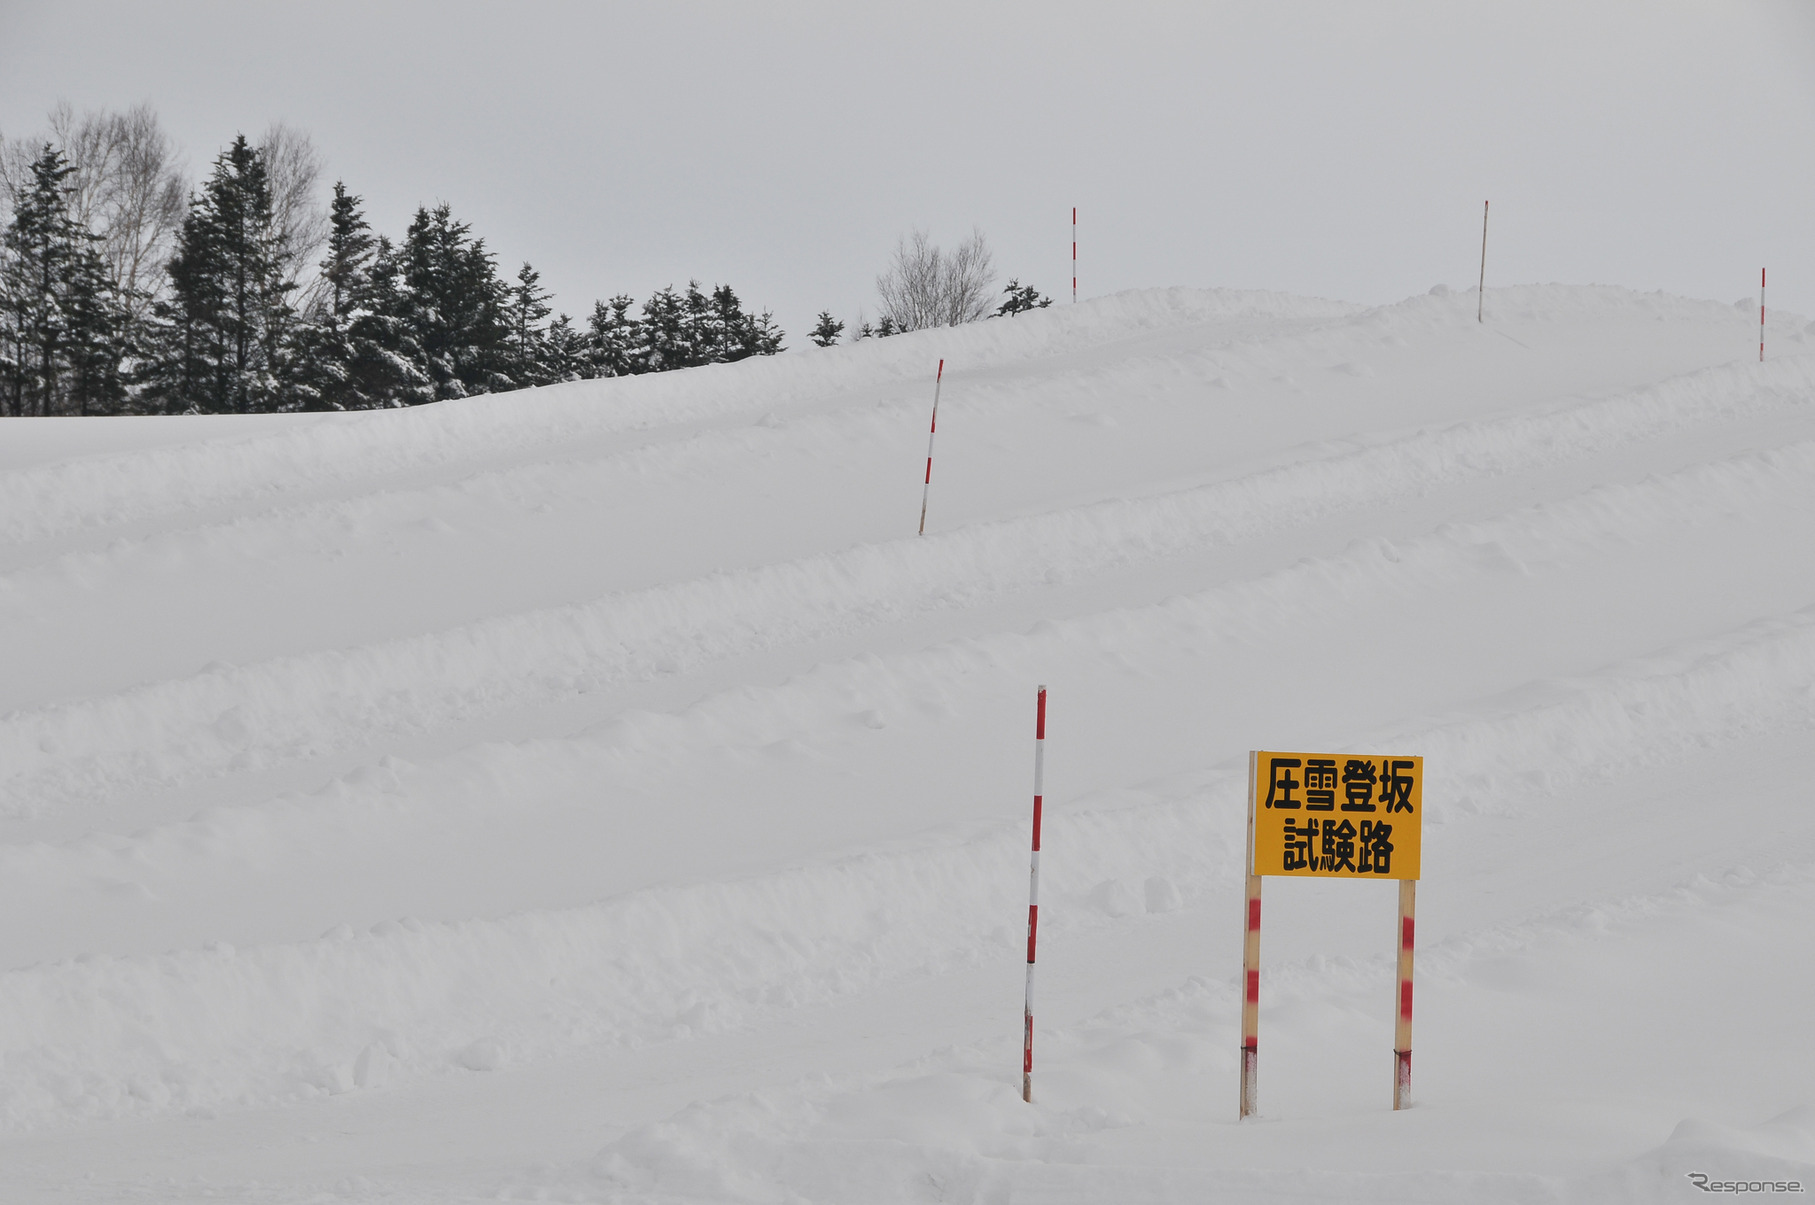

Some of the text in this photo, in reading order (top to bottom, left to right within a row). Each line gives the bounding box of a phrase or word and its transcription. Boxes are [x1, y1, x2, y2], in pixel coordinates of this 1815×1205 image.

[1265, 758, 1415, 813] 圧雪登坂
[1283, 818, 1395, 873] 試験路
